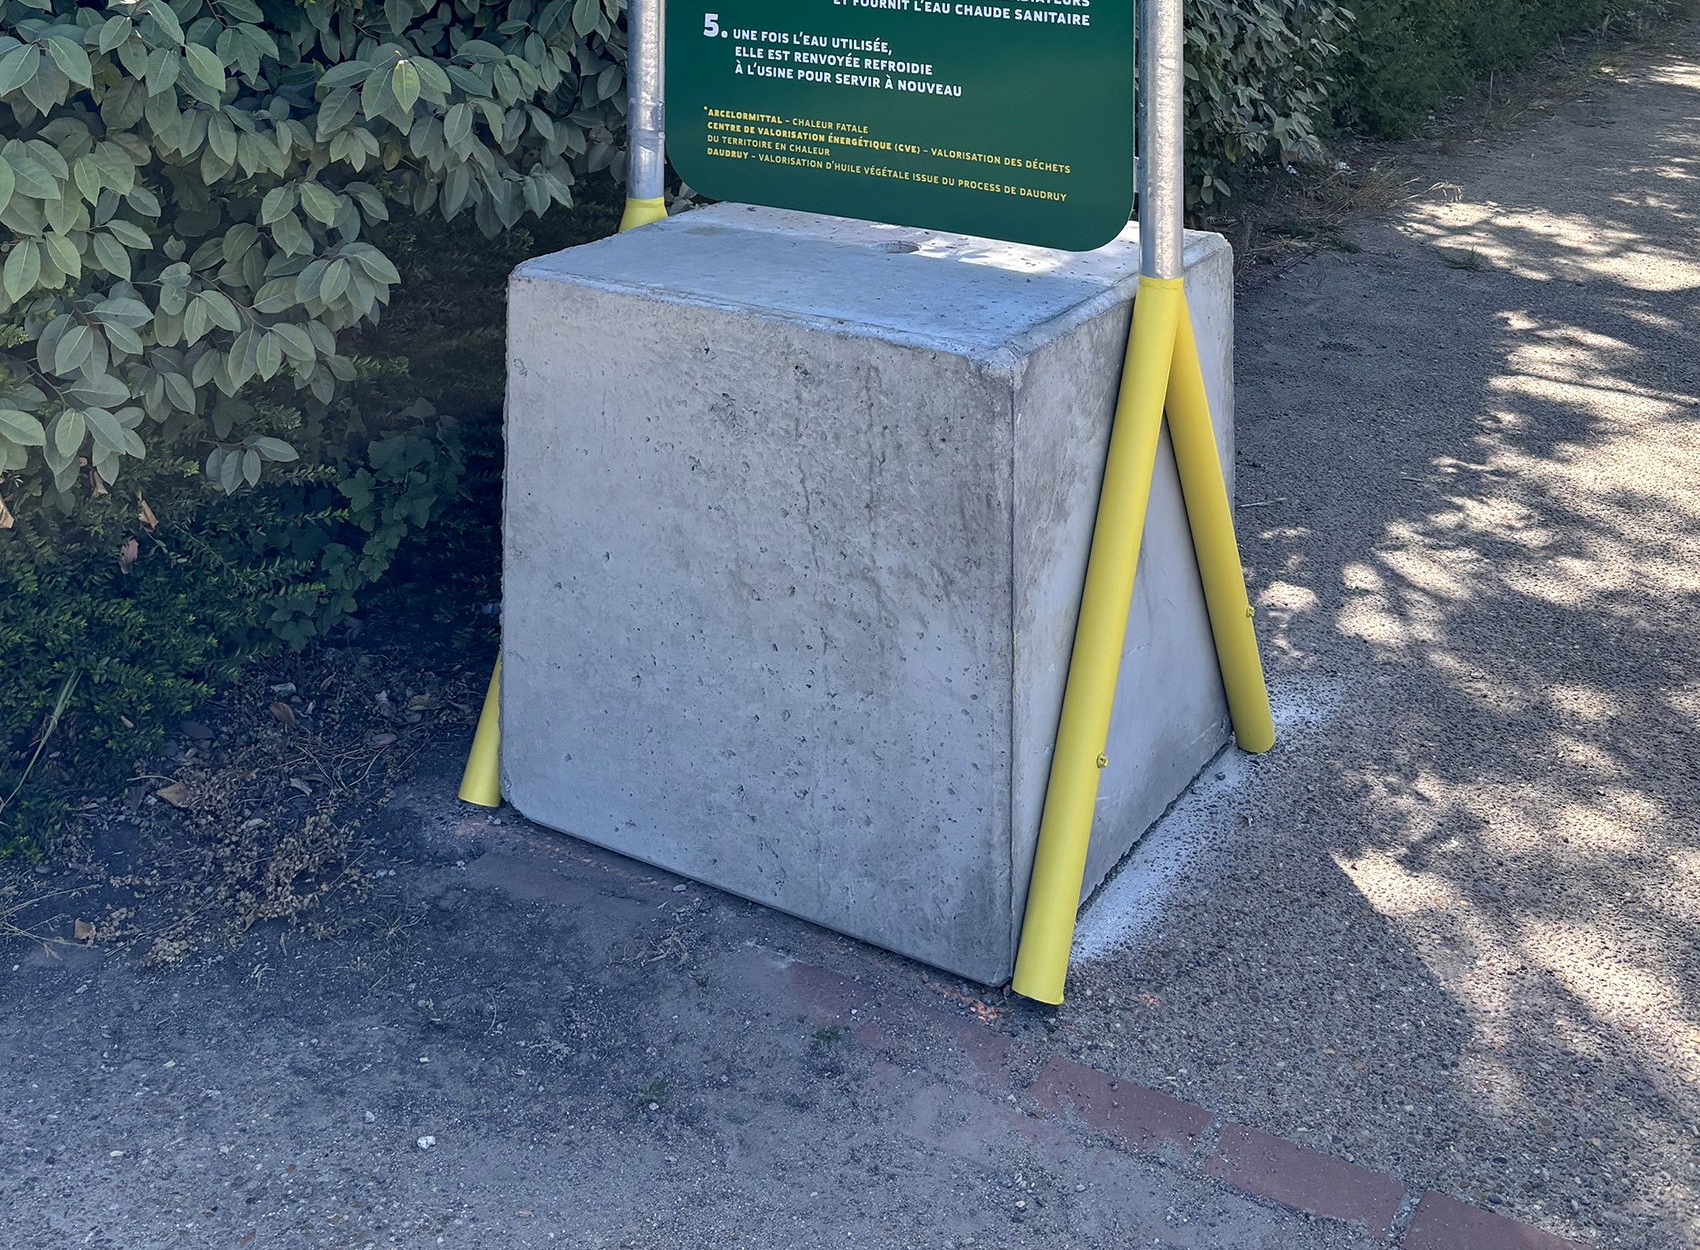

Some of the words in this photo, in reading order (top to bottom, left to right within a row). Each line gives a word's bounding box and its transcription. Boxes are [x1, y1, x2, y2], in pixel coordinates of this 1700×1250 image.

[955, 3, 1010, 18] CHAUDE
[1014, 8, 1089, 25] SANITAIRE
[703, 12, 727, 38] 5.
[733, 28, 757, 40] UNE
[761, 31, 788, 43] FOIS
[831, 37, 891, 55] UTILISÉE,
[735, 46, 763, 58] ELLE
[767, 49, 790, 60] EST
[794, 51, 860, 67] RENVOYÉE
[864, 58, 932, 75] REFROIDIE
[735, 59, 743, 74] À
[797, 69, 831, 83] POUR
[835, 73, 880, 88] SERVIR
[884, 74, 893, 89] À
[897, 79, 961, 96] NOUVEAU
[792, 117, 832, 129] CHALEUR
[836, 122, 868, 133] FATALE
[707, 134, 718, 142] DU
[721, 135, 772, 149] TERRITOIRE
[775, 142, 786, 150] EN
[789, 143, 829, 155] CHALEUR
[707, 121, 740, 132] CENTRE
[743, 125, 754, 133] DE
[757, 127, 824, 141] VALORISATION
[827, 132, 891, 150] ÉNERGÉTIQUE
[894, 143, 920, 154] (CVE)
[930, 147, 1000, 164] VALORISATION
[1004, 157, 1022, 167] DES
[1025, 158, 1070, 173] DÉCHETS
[707, 147, 748, 159] DAUDRUY
[758, 153, 822, 168] VALORISATION
[863, 164, 909, 179] VÉGÉTALE
[912, 173, 938, 183] ISSUE
[942, 176, 954, 185] DU
[957, 179, 1000, 192] PROCESS
[1003, 185, 1016, 194] DE
[1019, 187, 1066, 201] DAUDRUY
